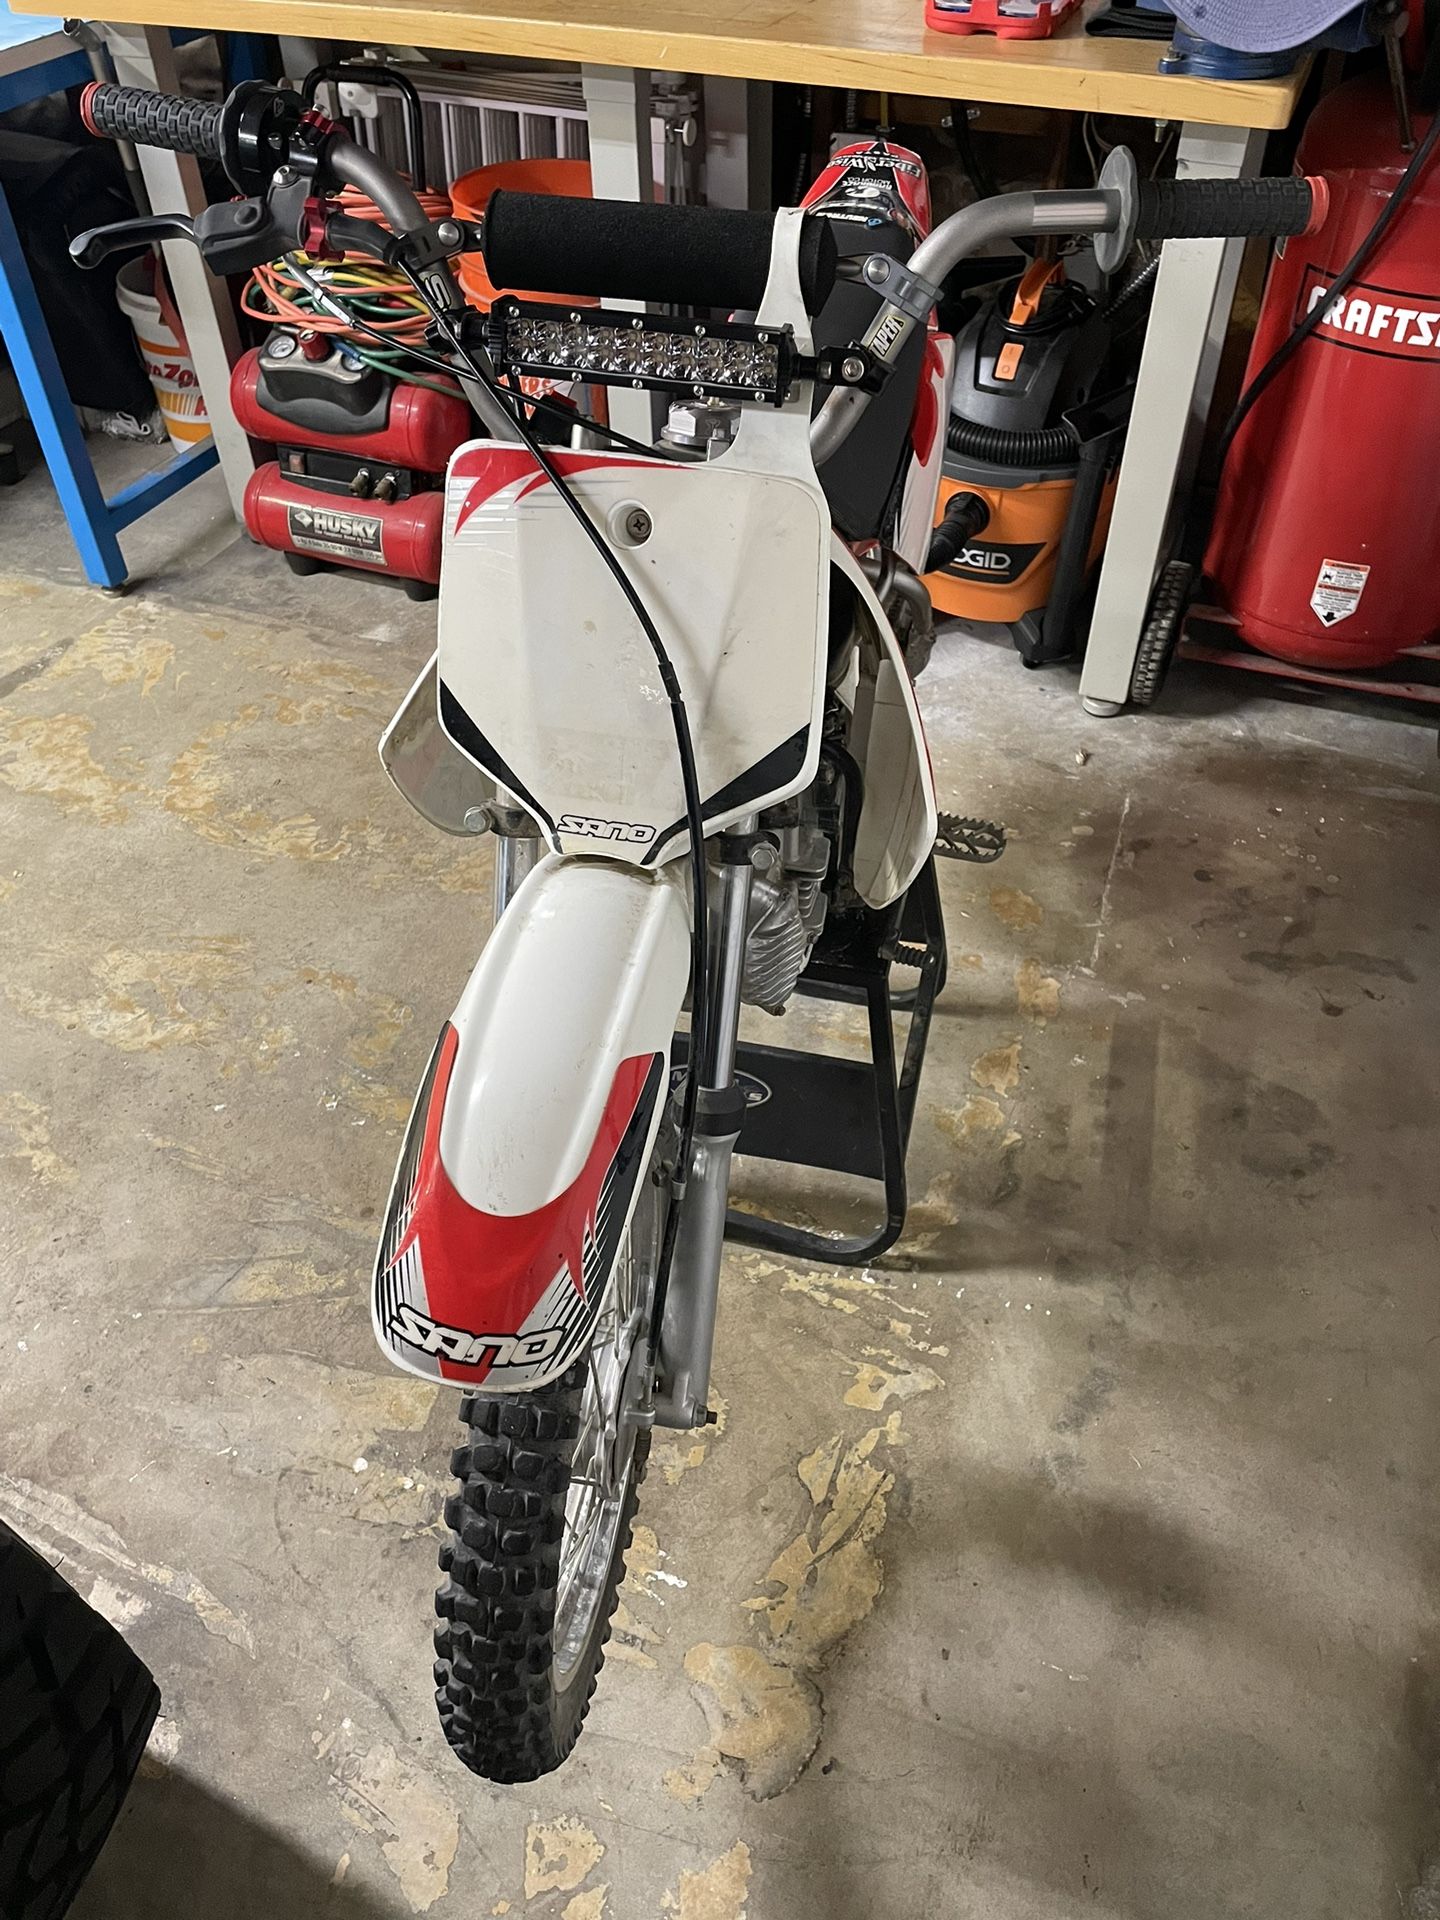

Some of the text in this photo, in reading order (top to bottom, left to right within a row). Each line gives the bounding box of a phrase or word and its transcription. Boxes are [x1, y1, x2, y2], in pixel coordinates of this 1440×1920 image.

[1307, 285, 1440, 347] CRAFTS
[313, 513, 378, 540] HUSKY
[557, 814, 657, 844] SANO
[387, 1302, 568, 1368] SANO
